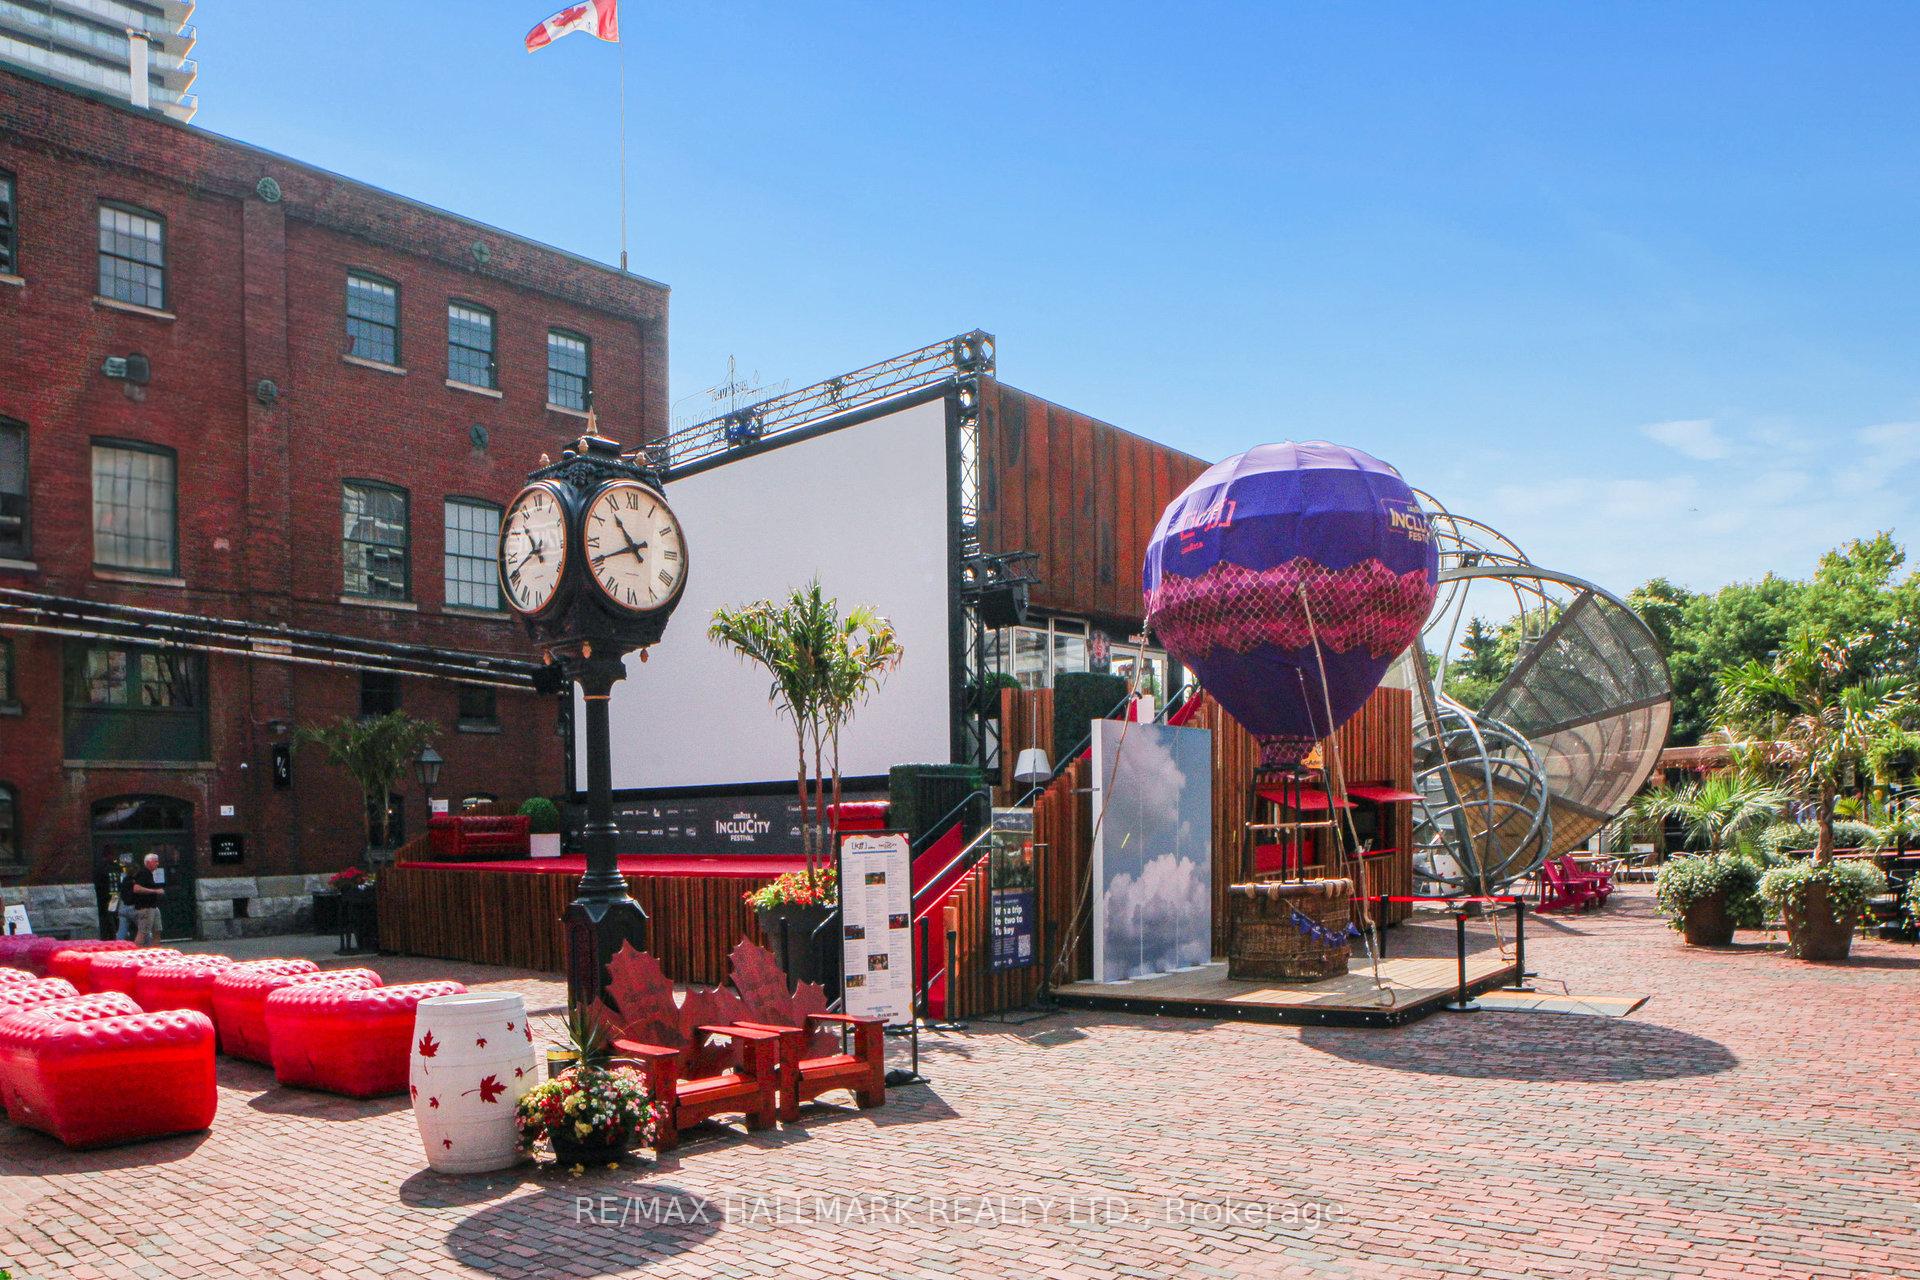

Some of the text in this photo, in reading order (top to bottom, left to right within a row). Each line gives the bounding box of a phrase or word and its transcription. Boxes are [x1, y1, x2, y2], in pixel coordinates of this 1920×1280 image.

[730, 834, 755, 842] FESTIVAL
[1011, 904, 1023, 915] trip
[1004, 917, 1016, 925] two
[1016, 915, 1024, 923] to
[994, 926, 1015, 936] Tukey
